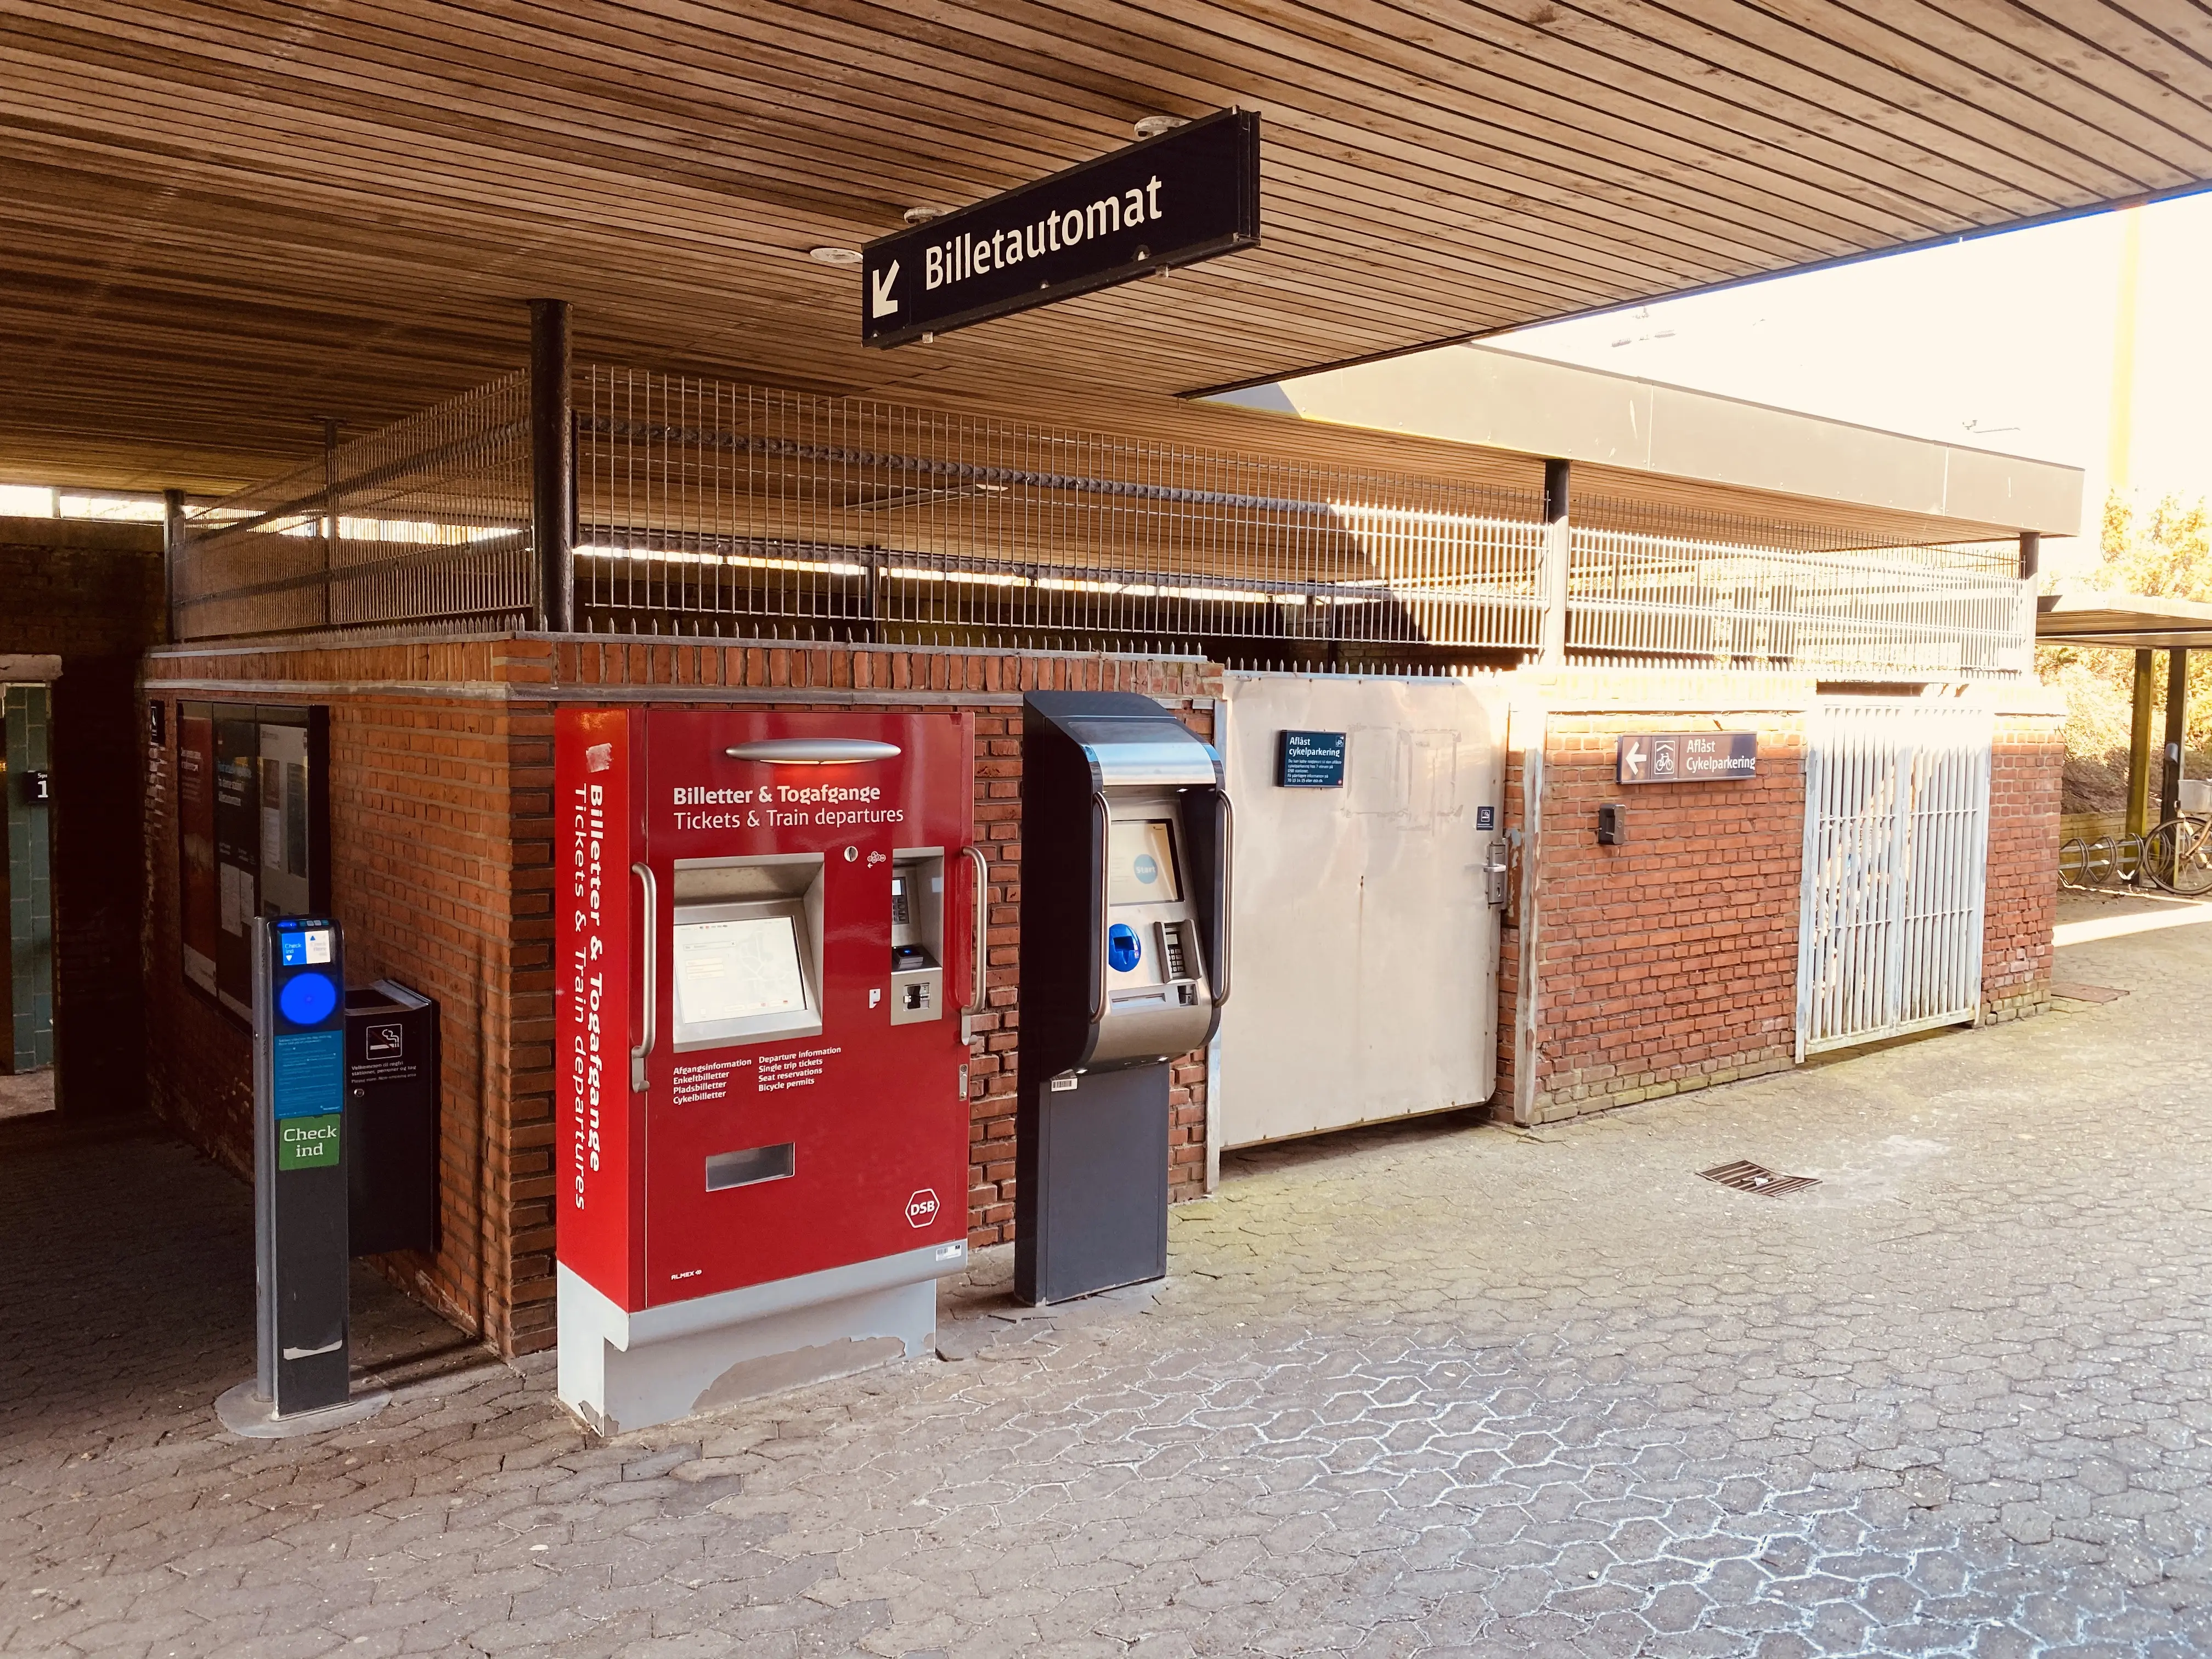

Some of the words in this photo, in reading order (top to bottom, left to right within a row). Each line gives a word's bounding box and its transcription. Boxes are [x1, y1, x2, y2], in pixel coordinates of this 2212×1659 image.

[926, 174, 1162, 291] Billetautomat
[1289, 736, 1311, 746] Aflåst
[1686, 738, 1716, 753] Aflåst
[1289, 747, 1340, 758] cykelparkering
[1686, 755, 1756, 774] Cykelparkering
[37, 780, 48, 798] 1
[673, 785, 754, 805] Billetter
[758, 786, 773, 803] &
[777, 783, 881, 805] Togafgange
[673, 810, 741, 830] Tickets
[747, 810, 760, 827] &
[766, 808, 809, 827] Train
[815, 807, 904, 828] departures
[574, 783, 587, 898] Tickets
[590, 784, 603, 927] Billetter
[574, 910, 587, 933] &
[589, 935, 603, 961] &
[574, 946, 587, 1023] Train
[758, 1052, 797, 1064] Departure
[798, 1046, 842, 1058] information
[588, 972, 603, 1172] Togafgange
[673, 1058, 752, 1075] Afgangsinformation
[758, 1063, 782, 1074] Single
[783, 1061, 797, 1070] trip
[798, 1058, 823, 1068] tickets
[673, 1071, 730, 1085] Enkeltbilletter
[758, 1074, 776, 1083] Seat
[777, 1067, 823, 1080] reservations
[673, 1081, 727, 1094] Pladsbilletter
[758, 1081, 785, 1092] Bicycle
[786, 1077, 815, 1090] permits
[673, 1090, 727, 1105] Cykelbilletter
[572, 1035, 587, 1211] departures
[284, 1125, 337, 1142] Check
[296, 1142, 323, 1158] ind
[910, 1200, 935, 1216] DSB
[671, 1271, 695, 1280] ALMEX
